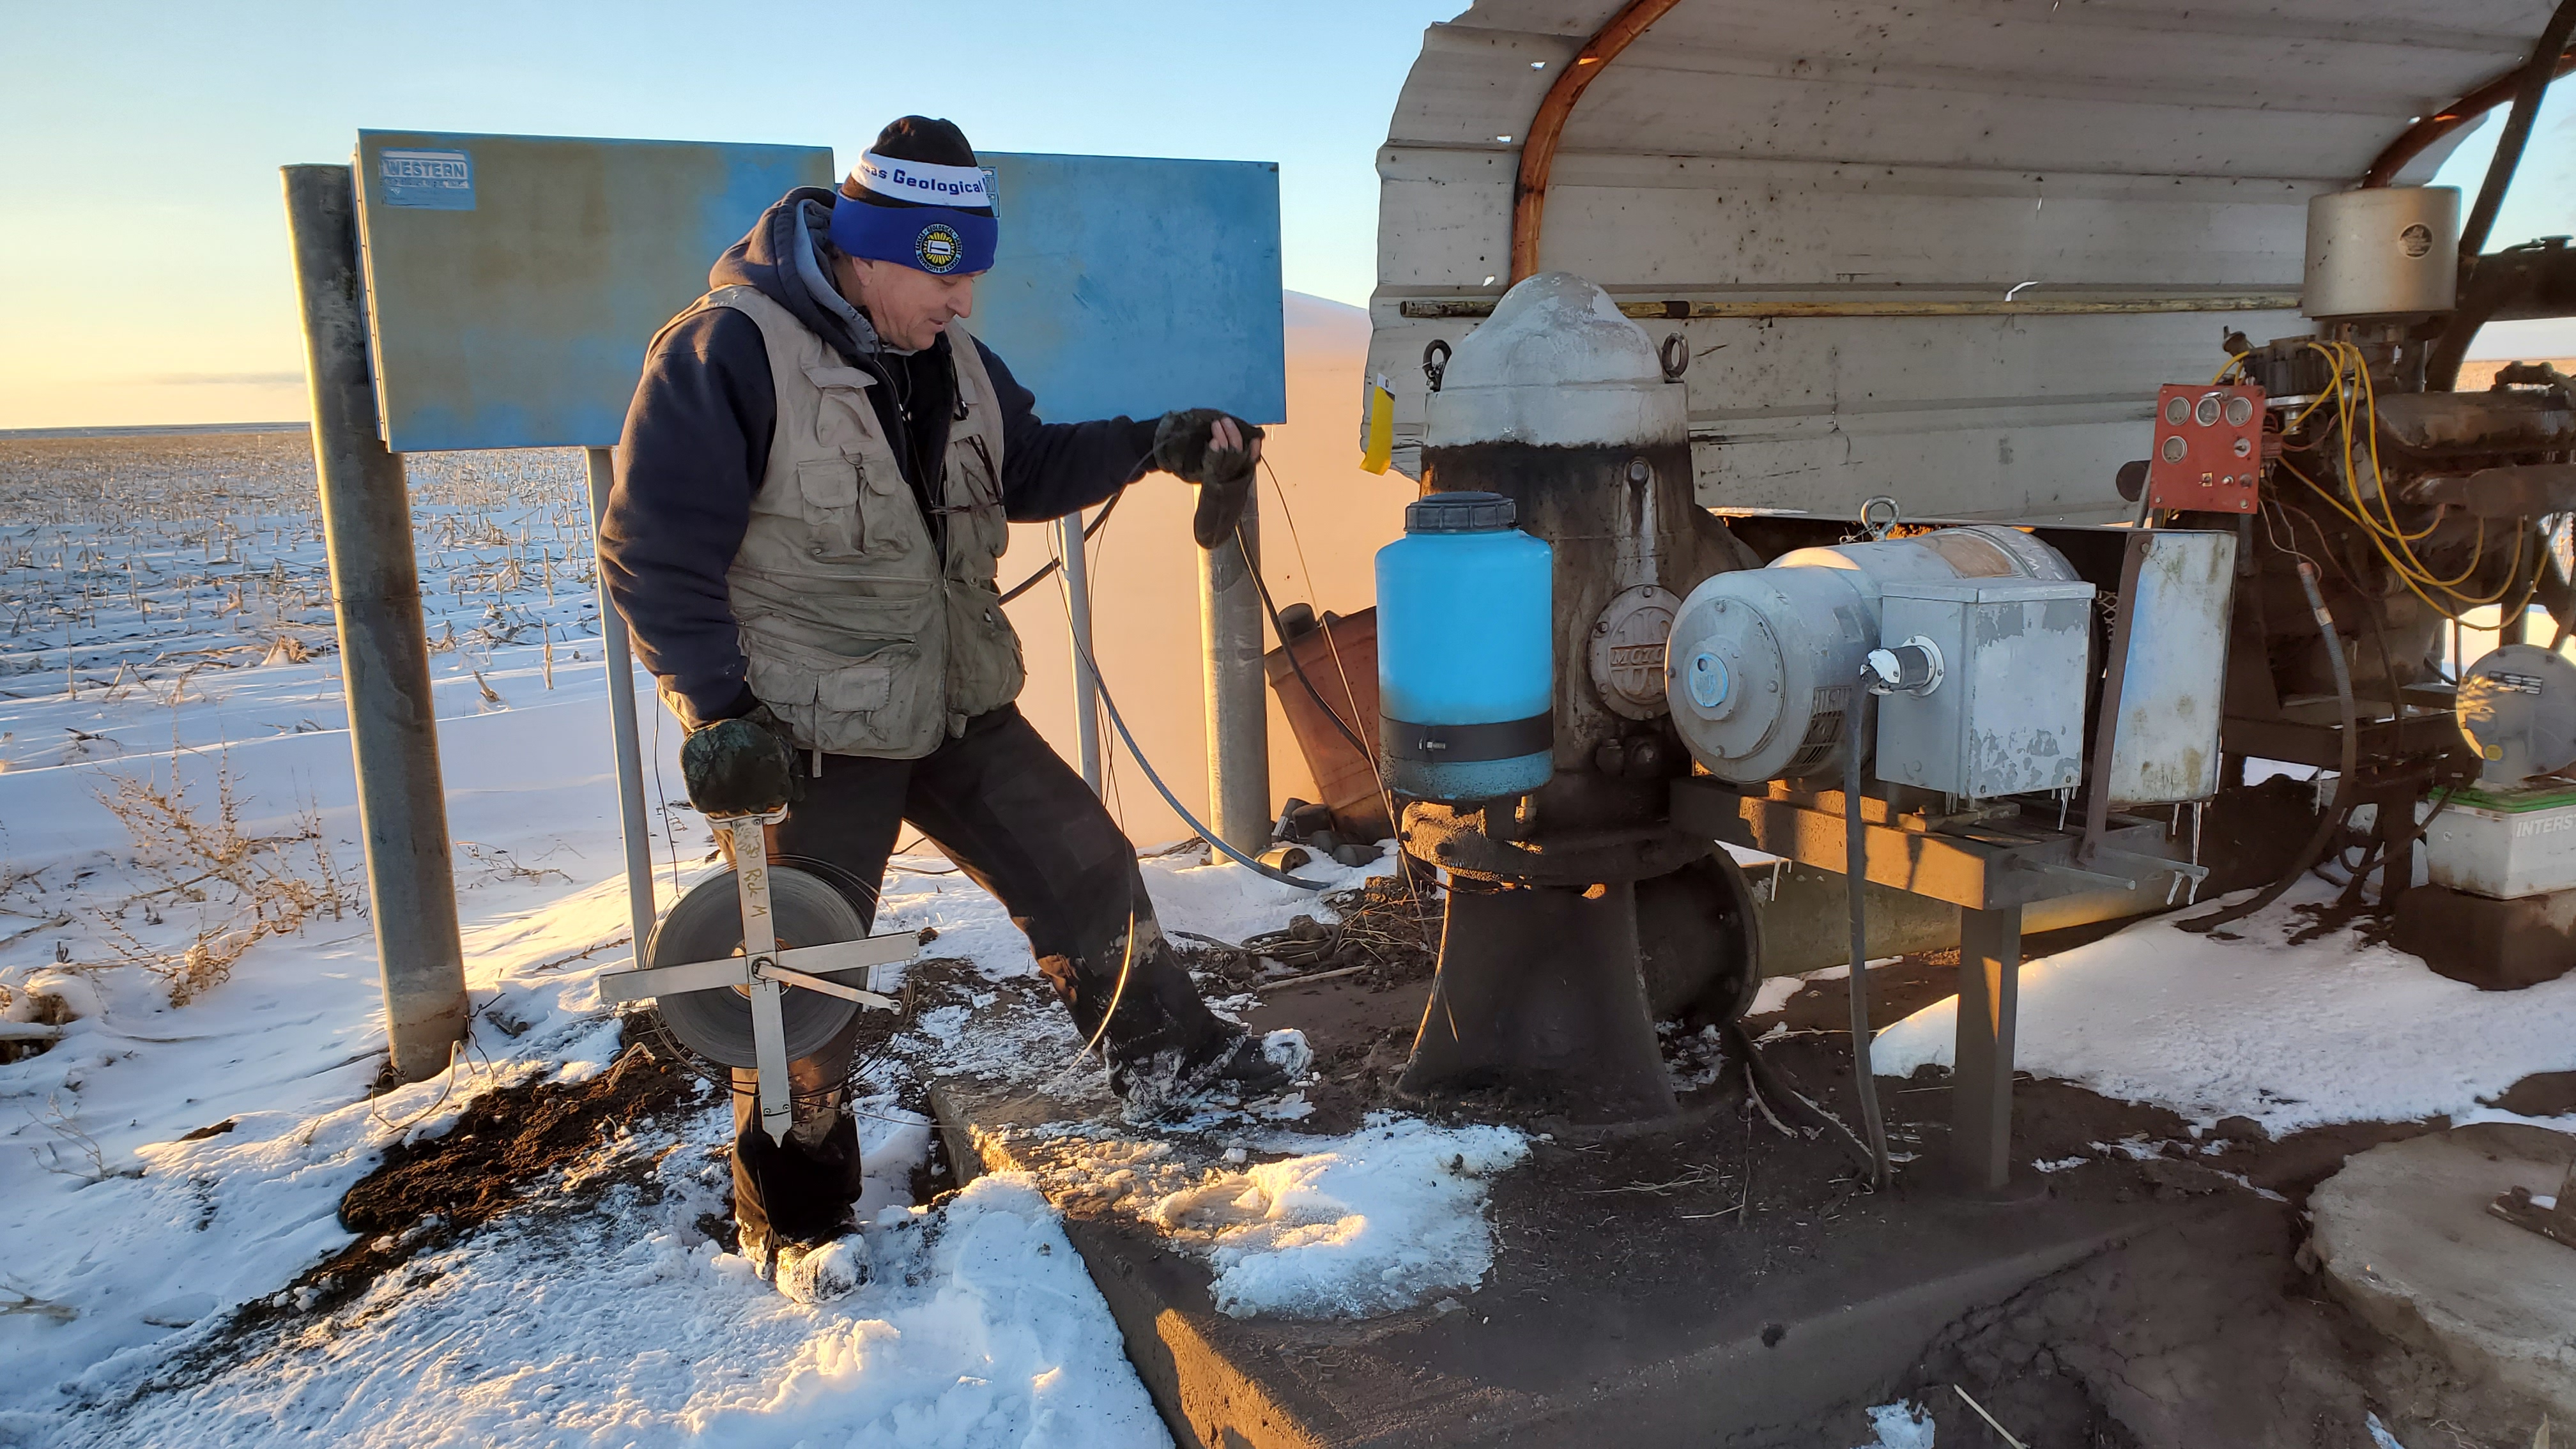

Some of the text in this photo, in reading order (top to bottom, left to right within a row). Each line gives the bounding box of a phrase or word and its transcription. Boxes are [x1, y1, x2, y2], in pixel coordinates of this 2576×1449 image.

[385, 160, 464, 178] WESTERN
[893, 169, 984, 195] Geological
[743, 868, 768, 918] Rick M
